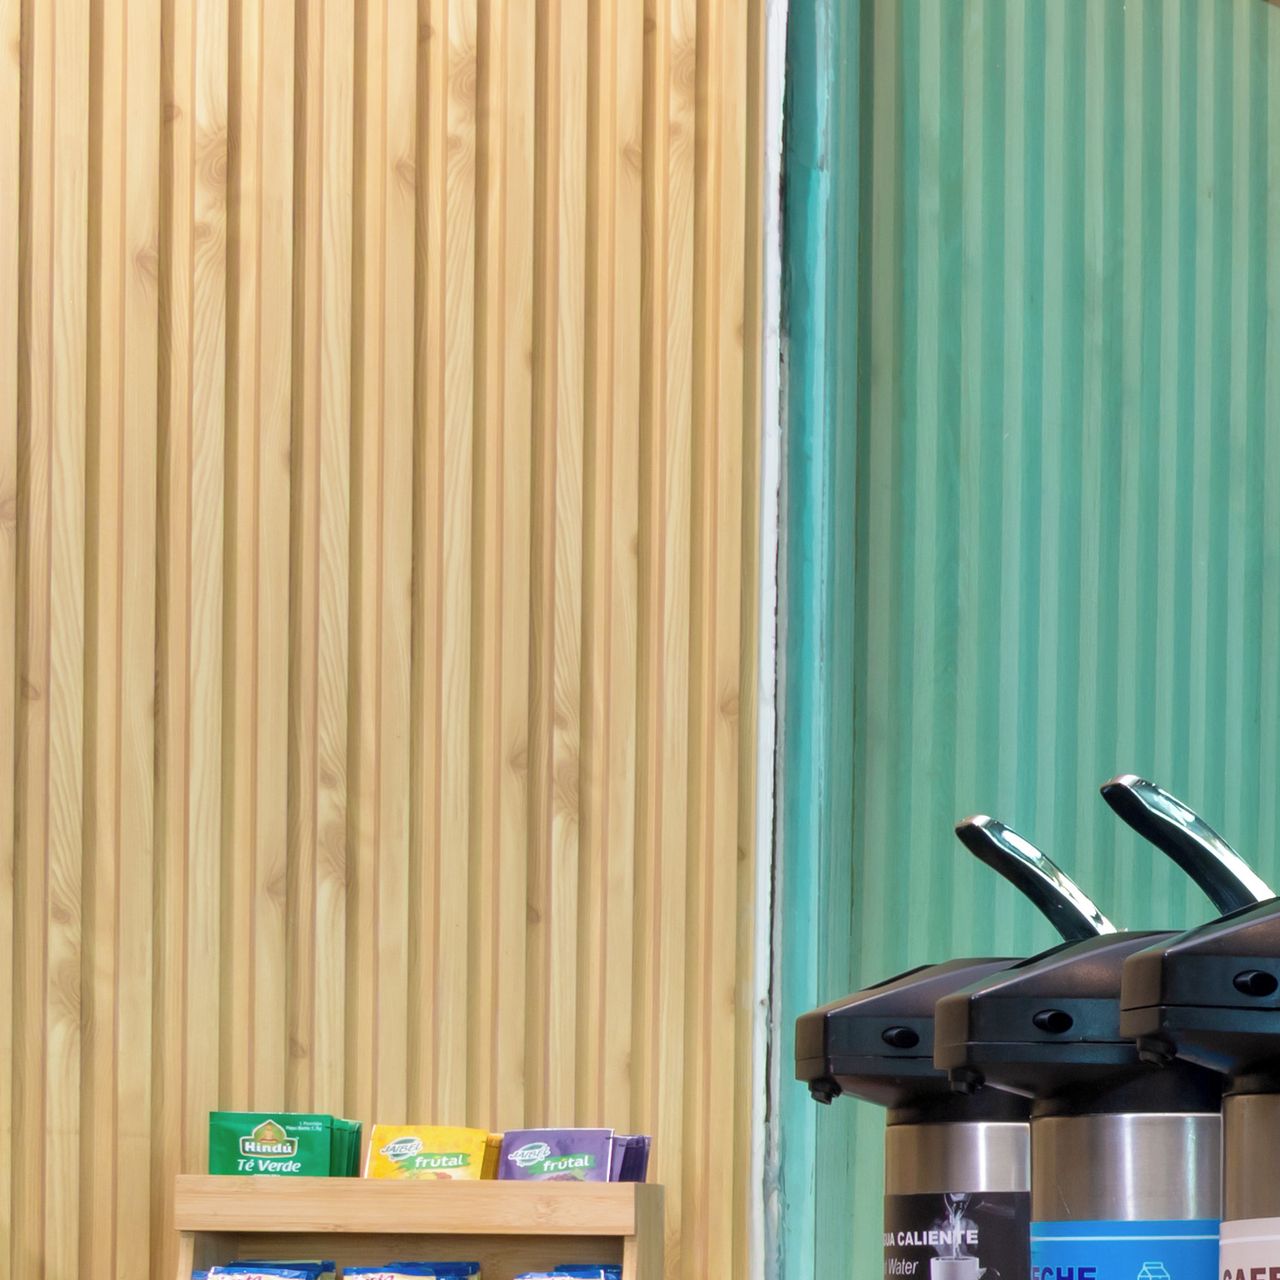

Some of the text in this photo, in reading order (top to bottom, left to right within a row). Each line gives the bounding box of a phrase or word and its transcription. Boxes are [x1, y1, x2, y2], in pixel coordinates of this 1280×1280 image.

[244, 1141, 292, 1154] Hindú
[237, 1158, 302, 1173] Té Verde
[897, 1230, 979, 1246] CALIENTE
[888, 1258, 919, 1275] Water
